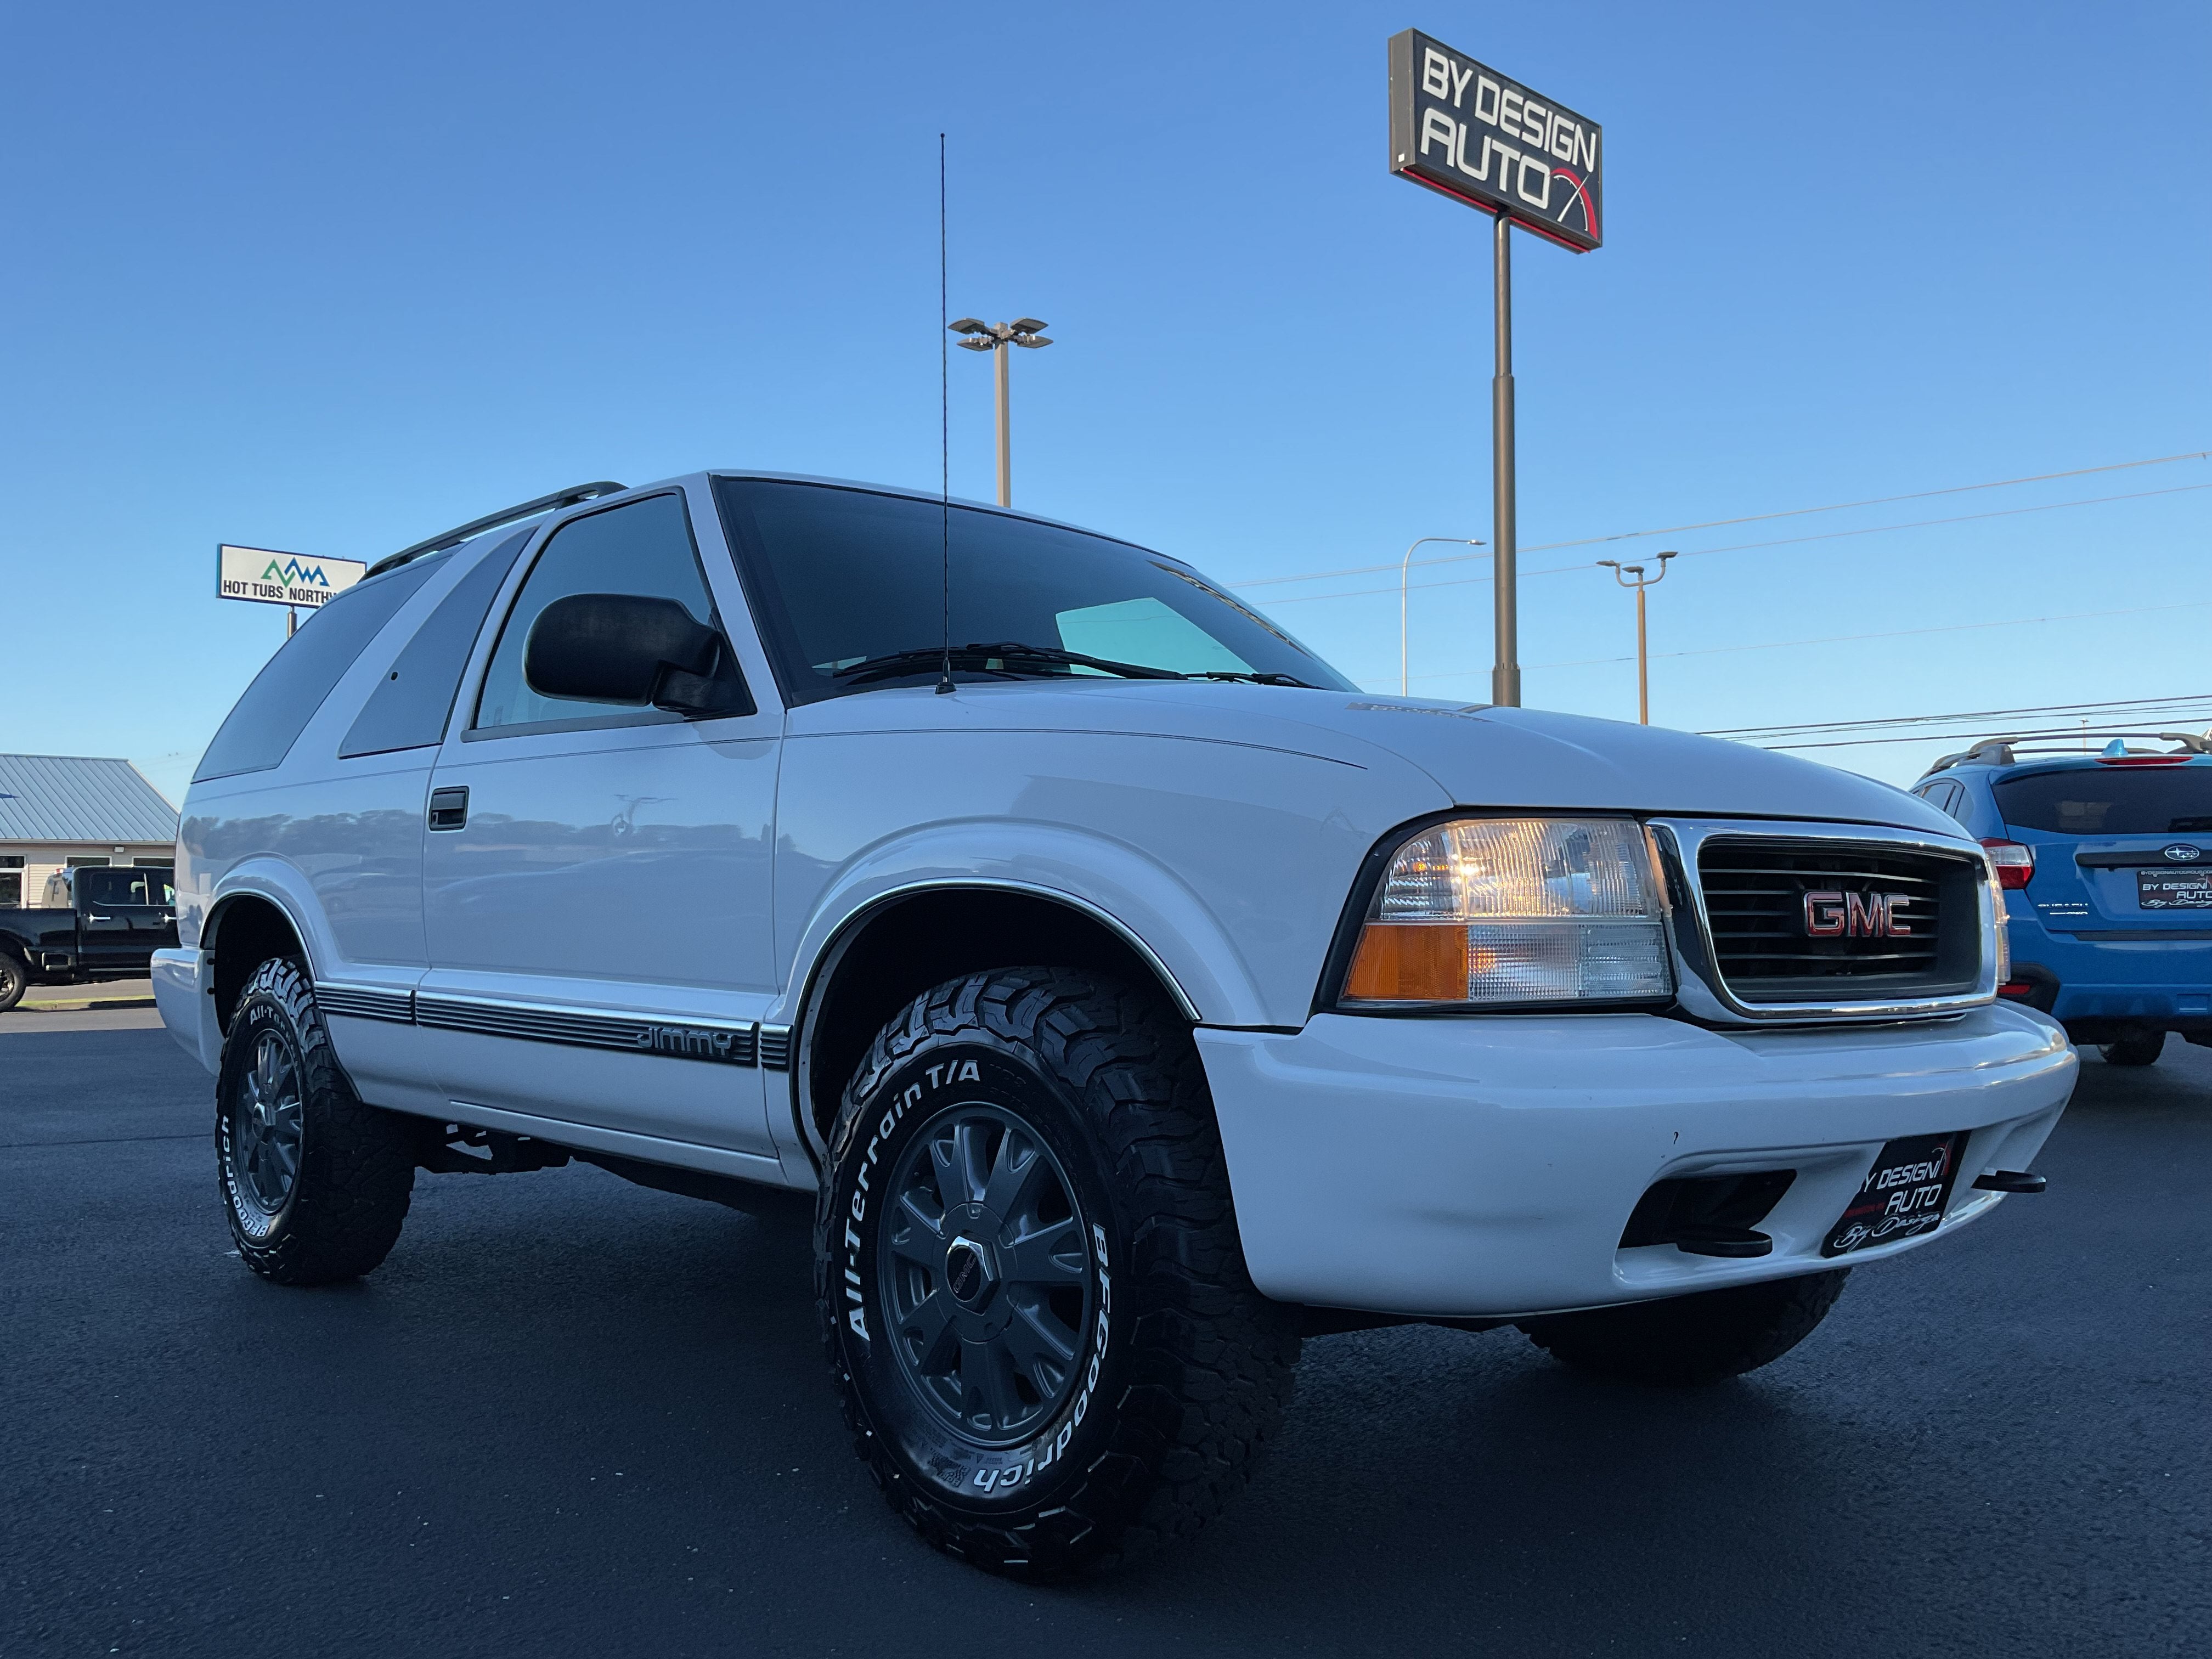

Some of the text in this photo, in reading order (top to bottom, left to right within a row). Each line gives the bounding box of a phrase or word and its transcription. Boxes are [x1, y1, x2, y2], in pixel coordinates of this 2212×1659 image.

[1423, 47, 1596, 173] BY DESIGN
[1420, 108, 1551, 210] AUTO
[223, 580, 249, 595] HOT
[252, 583, 283, 599] TUBS
[1804, 891, 1911, 937] GMC
[1864, 1160, 1940, 1192] Y DESIGN
[845, 1059, 980, 1341] All-Terrain T/A
[1884, 1184, 1942, 1215] AUTO
[953, 1251, 977, 1294] GMC
[973, 1223, 1111, 1492] BFGoodrich
